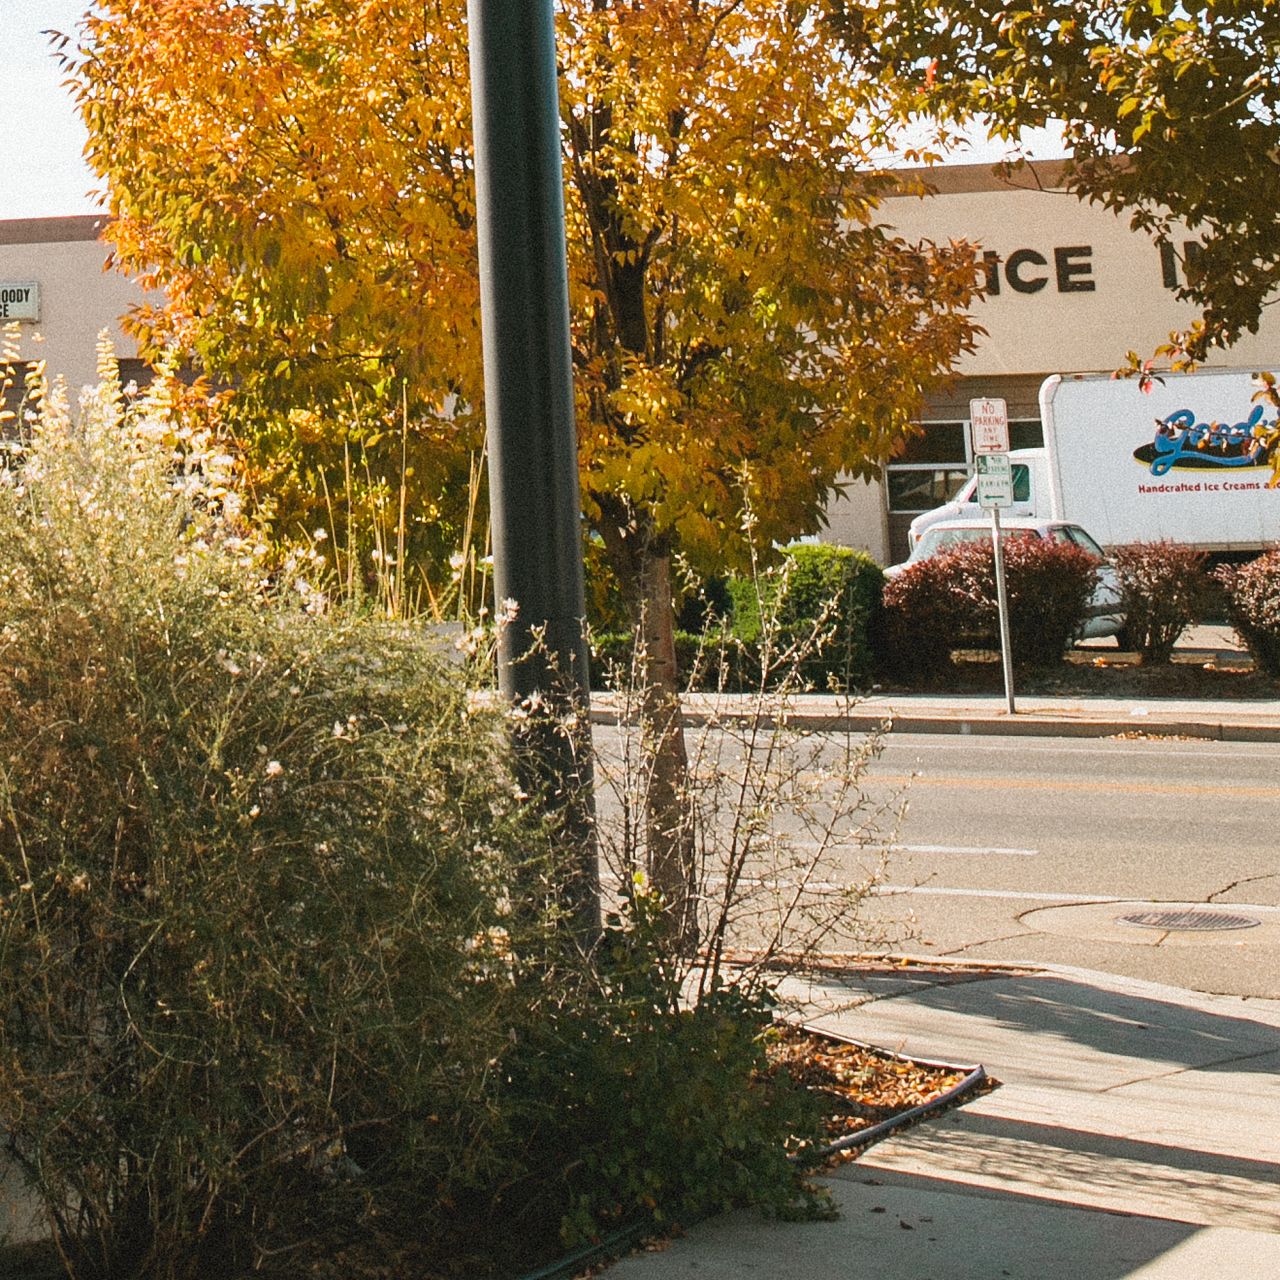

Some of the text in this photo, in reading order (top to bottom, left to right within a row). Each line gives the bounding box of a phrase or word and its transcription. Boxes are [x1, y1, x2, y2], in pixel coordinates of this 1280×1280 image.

[982, 245, 1096, 295] ICE
[982, 405, 995, 414] NO
[974, 416, 1004, 426] PARKING
[1138, 483, 1200, 493] Handcrafted
[1204, 482, 1220, 491] Ice
[1222, 481, 1260, 491] Creams
